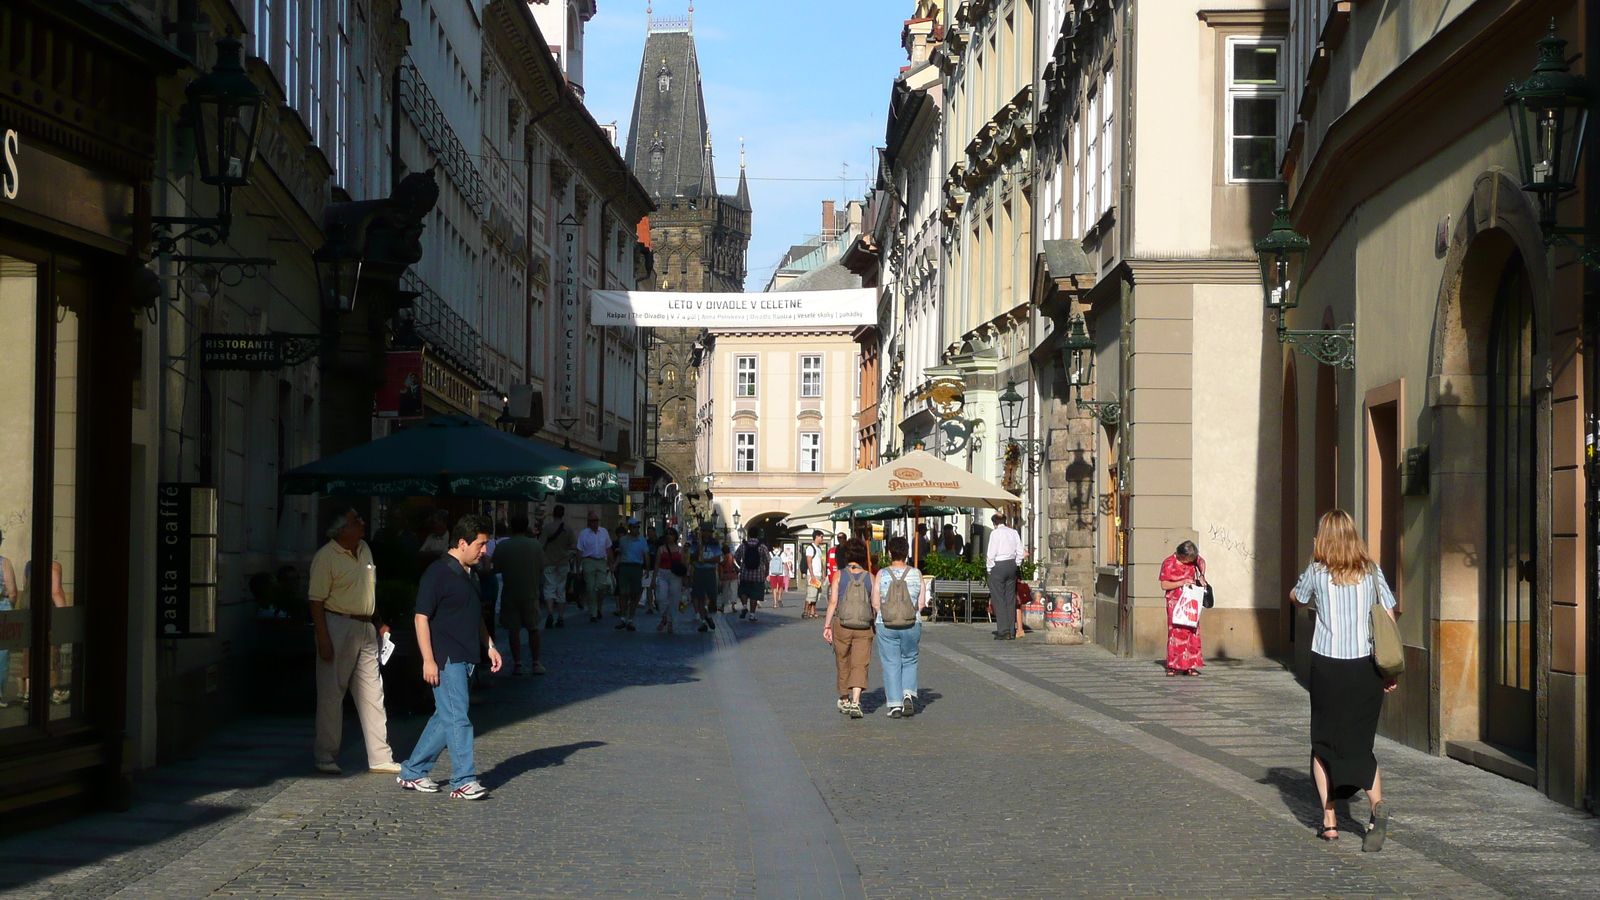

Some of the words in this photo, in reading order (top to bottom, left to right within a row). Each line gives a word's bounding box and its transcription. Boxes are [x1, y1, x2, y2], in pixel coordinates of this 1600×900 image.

[566, 233, 574, 306] DIVADLO
[696, 301, 703, 309] V
[706, 300, 747, 309] DIVADLE
[750, 301, 757, 309] V
[205, 339, 275, 349] RISTORANTE
[888, 479, 925, 491] Pilsner
[924, 479, 960, 489] Urquell
[160, 486, 179, 545] caffé
